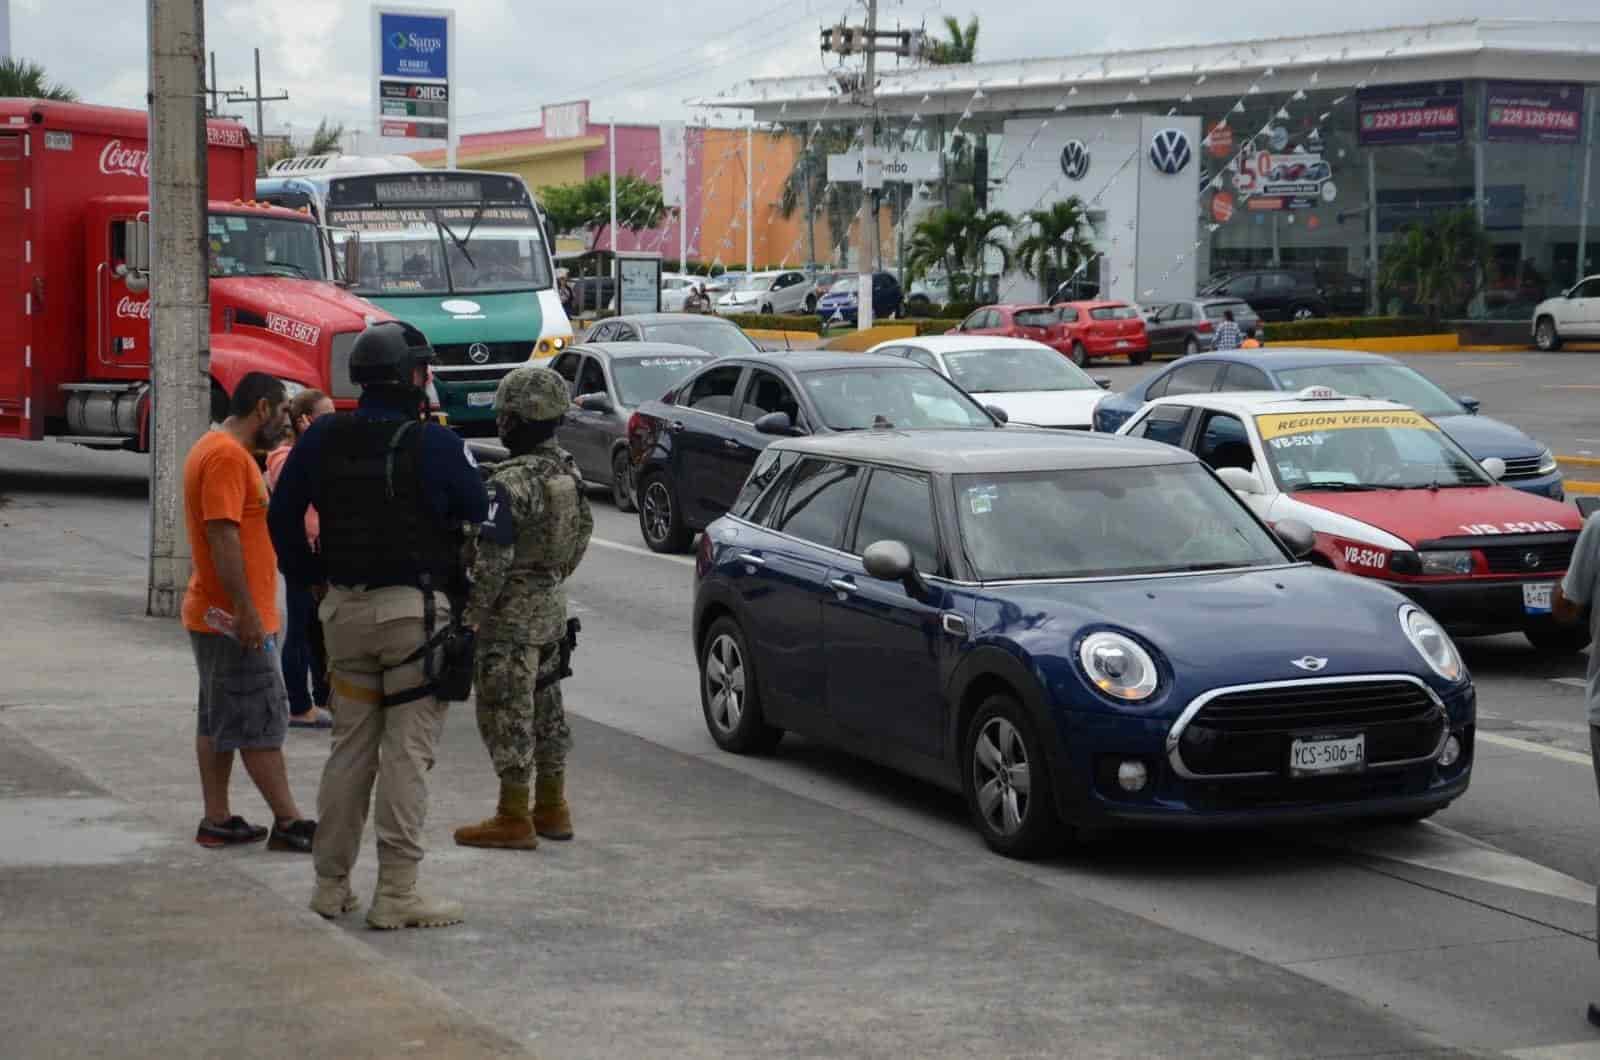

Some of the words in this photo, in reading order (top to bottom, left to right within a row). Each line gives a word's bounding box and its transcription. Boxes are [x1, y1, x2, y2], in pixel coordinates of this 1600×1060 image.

[207, 127, 244, 146] ER-15671
[266, 313, 320, 346] VER-15671
[1311, 390, 1333, 398] TAXI
[1277, 415, 1338, 431] REGION
[1342, 413, 1419, 426] VERACRUZ
[1344, 546, 1385, 569] VB-5210
[1295, 743, 1362, 765] YCS-506-A
